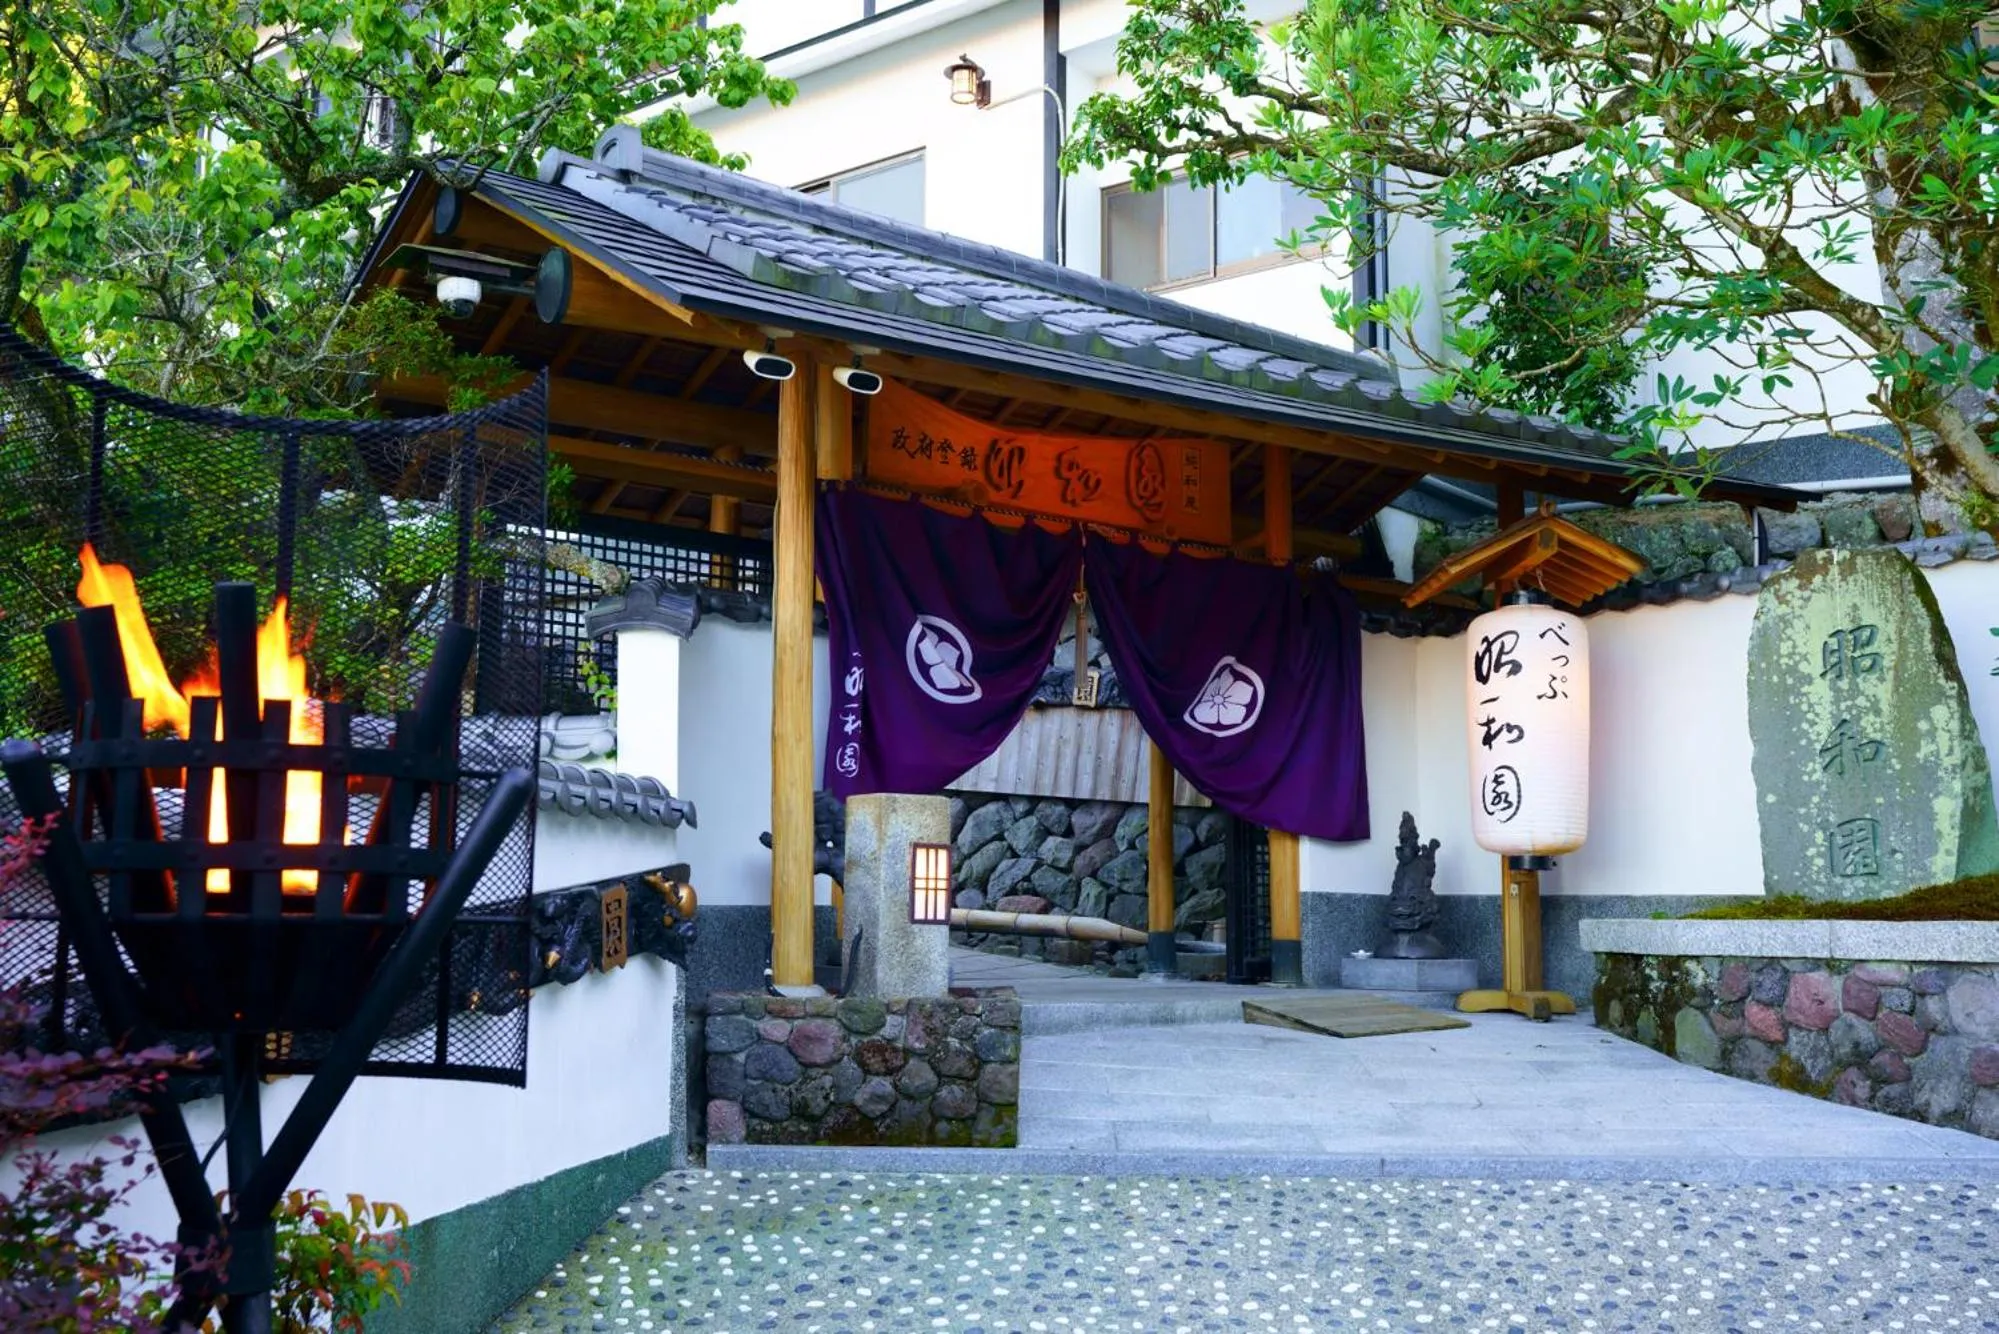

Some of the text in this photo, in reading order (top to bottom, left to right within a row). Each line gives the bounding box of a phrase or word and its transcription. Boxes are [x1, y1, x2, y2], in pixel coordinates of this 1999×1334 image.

[1474, 629, 1525, 823] 昭和園
[1537, 622, 1570, 700] べっぷ
[1819, 624, 1887, 878] 昭和園
